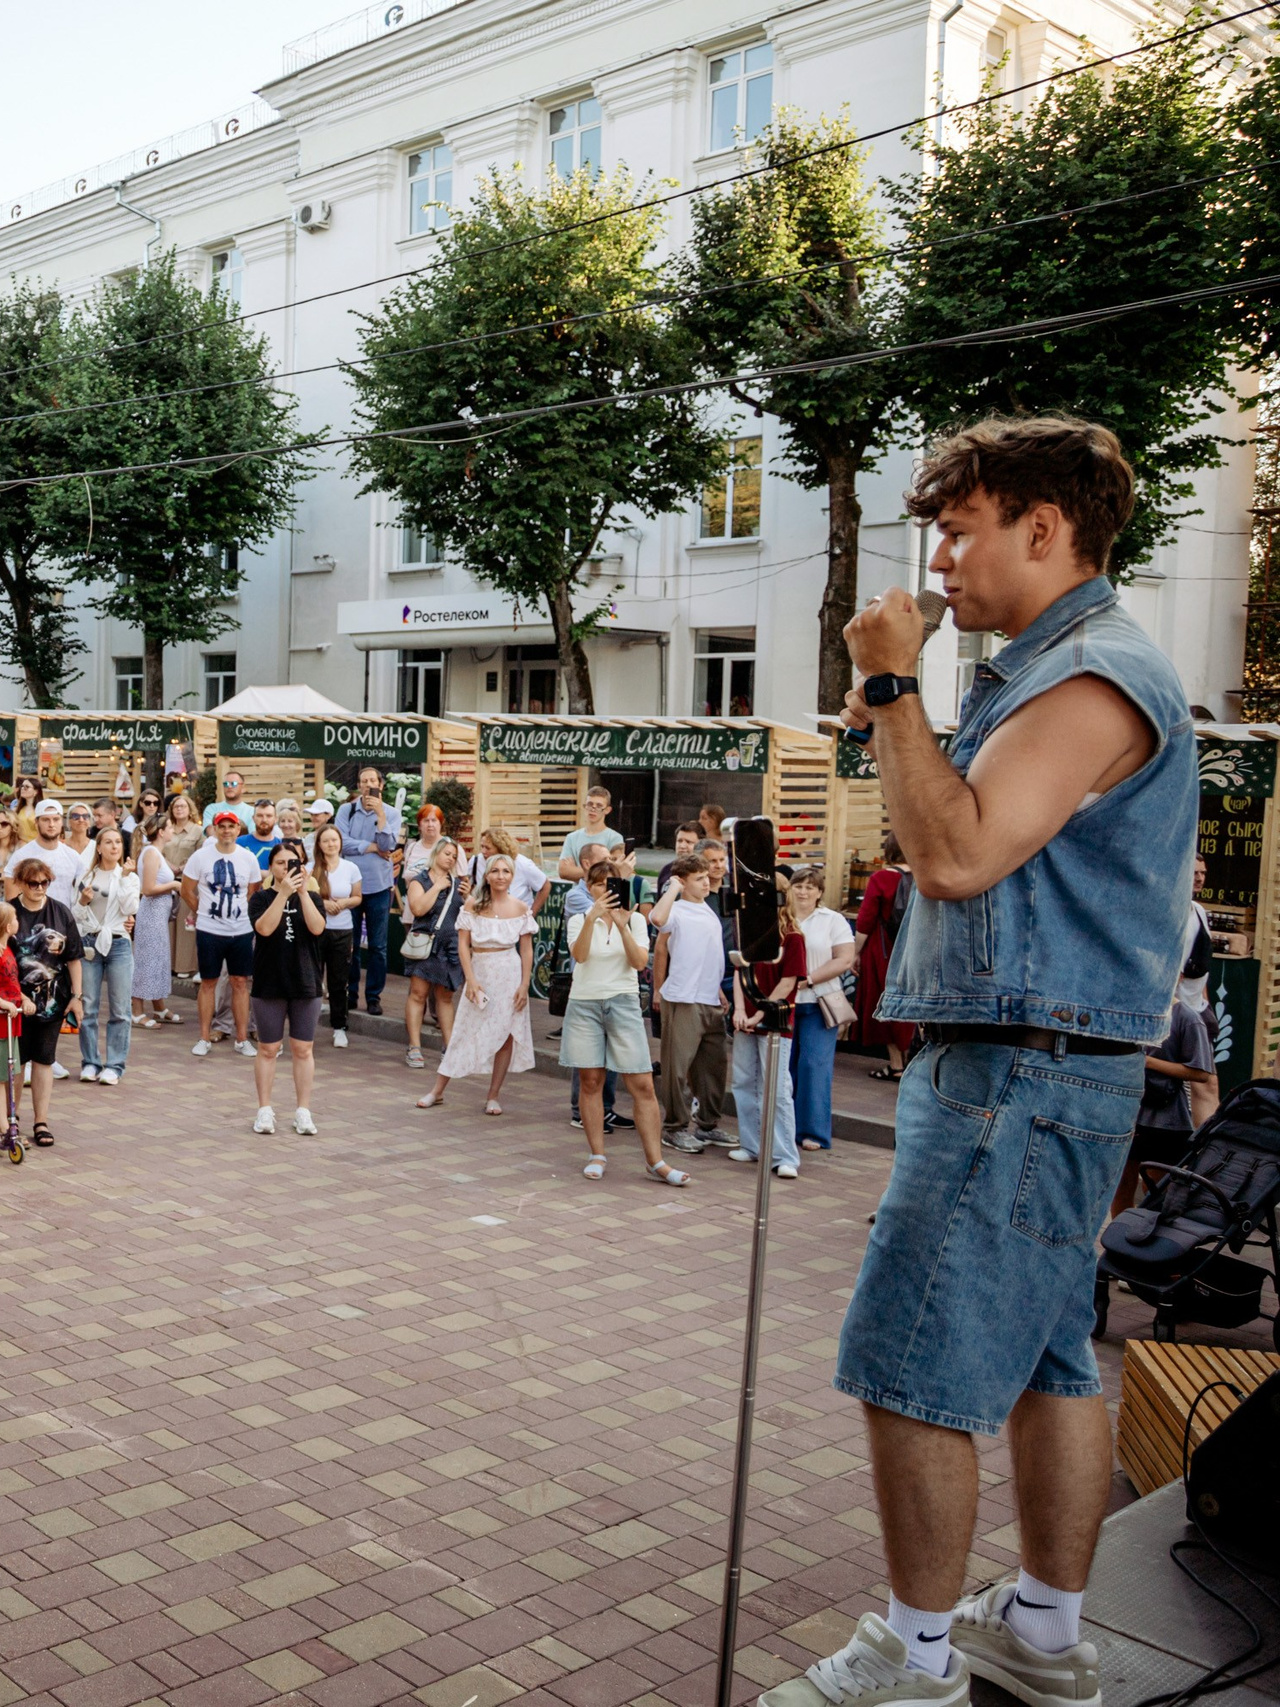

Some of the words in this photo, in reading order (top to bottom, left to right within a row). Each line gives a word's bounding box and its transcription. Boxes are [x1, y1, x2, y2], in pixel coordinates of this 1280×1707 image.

[413, 608, 489, 623] Ростелеком
[235, 724, 296, 740] Смоленские
[324, 725, 420, 748] ДОМИНО
[489, 726, 611, 752] Смоленские
[626, 730, 712, 754] Сласти
[248, 740, 286, 752] сезоны
[347, 748, 396, 758] рестораны
[519, 750, 575, 765] авторские
[639, 757, 648, 766] и
[863, 1621, 885, 1643] PUMA
